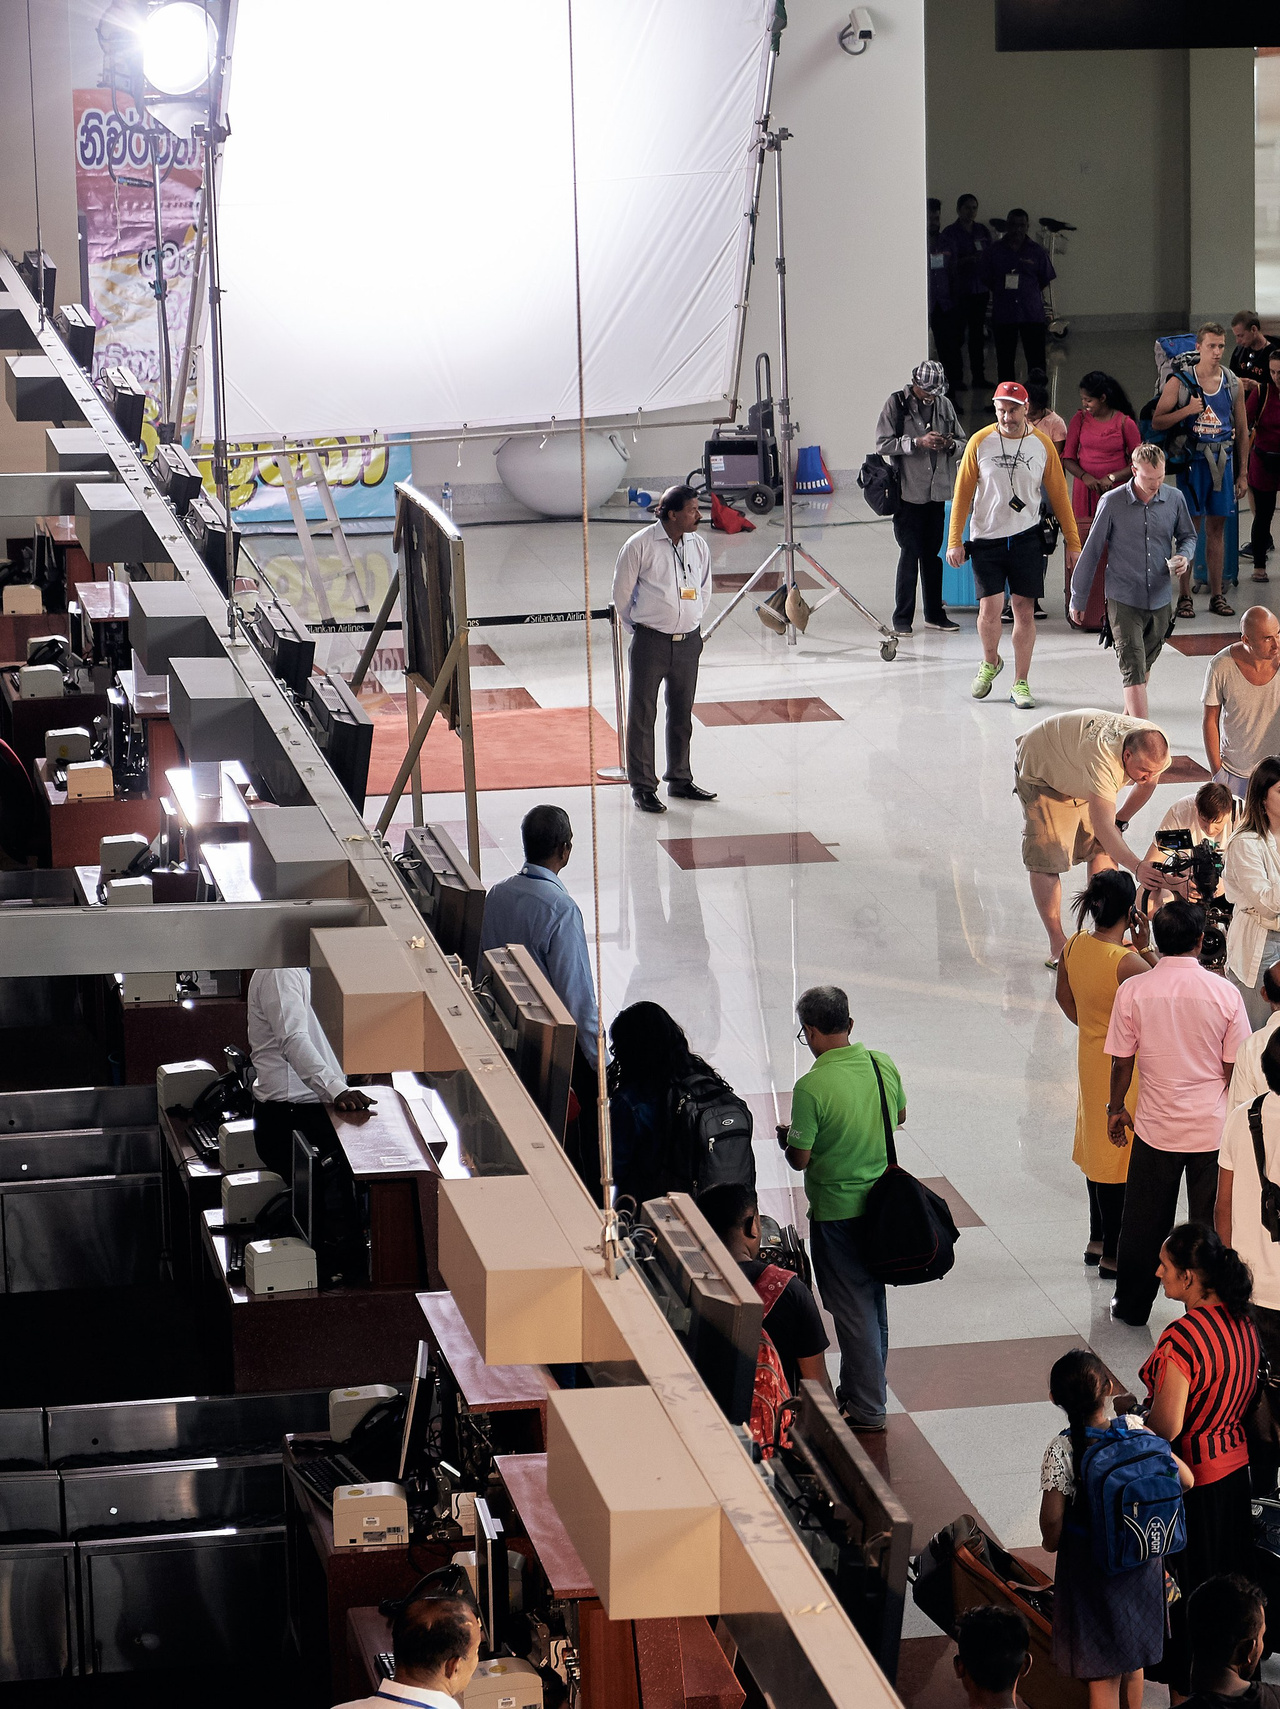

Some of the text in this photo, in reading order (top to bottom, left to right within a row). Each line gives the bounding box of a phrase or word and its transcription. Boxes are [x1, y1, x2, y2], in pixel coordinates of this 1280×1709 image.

[530, 613, 565, 624] SriLankan
[307, 623, 365, 634] iLankan Airlines
